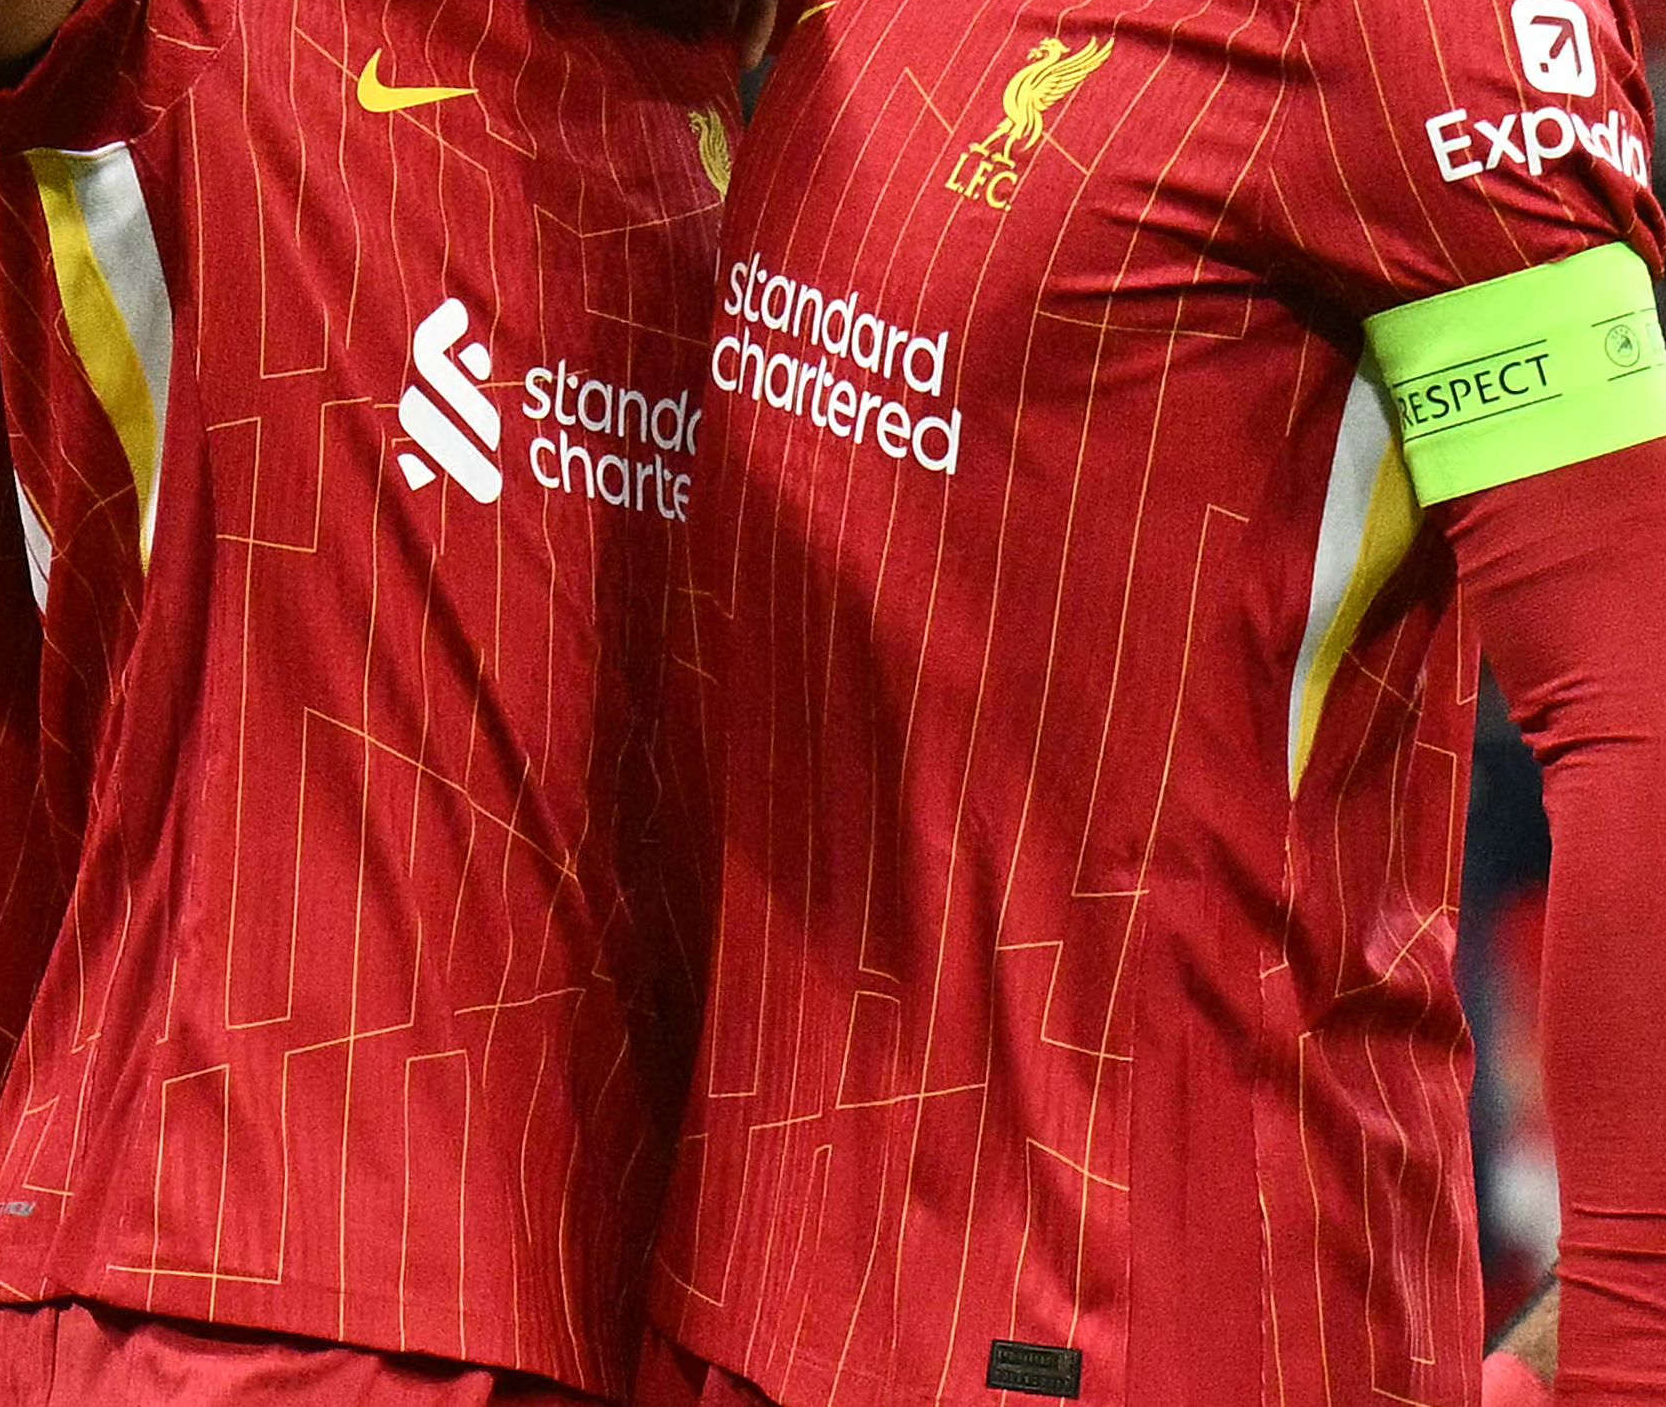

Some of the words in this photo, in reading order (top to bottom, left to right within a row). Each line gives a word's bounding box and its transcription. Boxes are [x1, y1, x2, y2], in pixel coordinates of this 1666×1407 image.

[724, 252, 949, 397] standard
[1397, 353, 1550, 431] RESPECT
[711, 326, 962, 475] chartered
